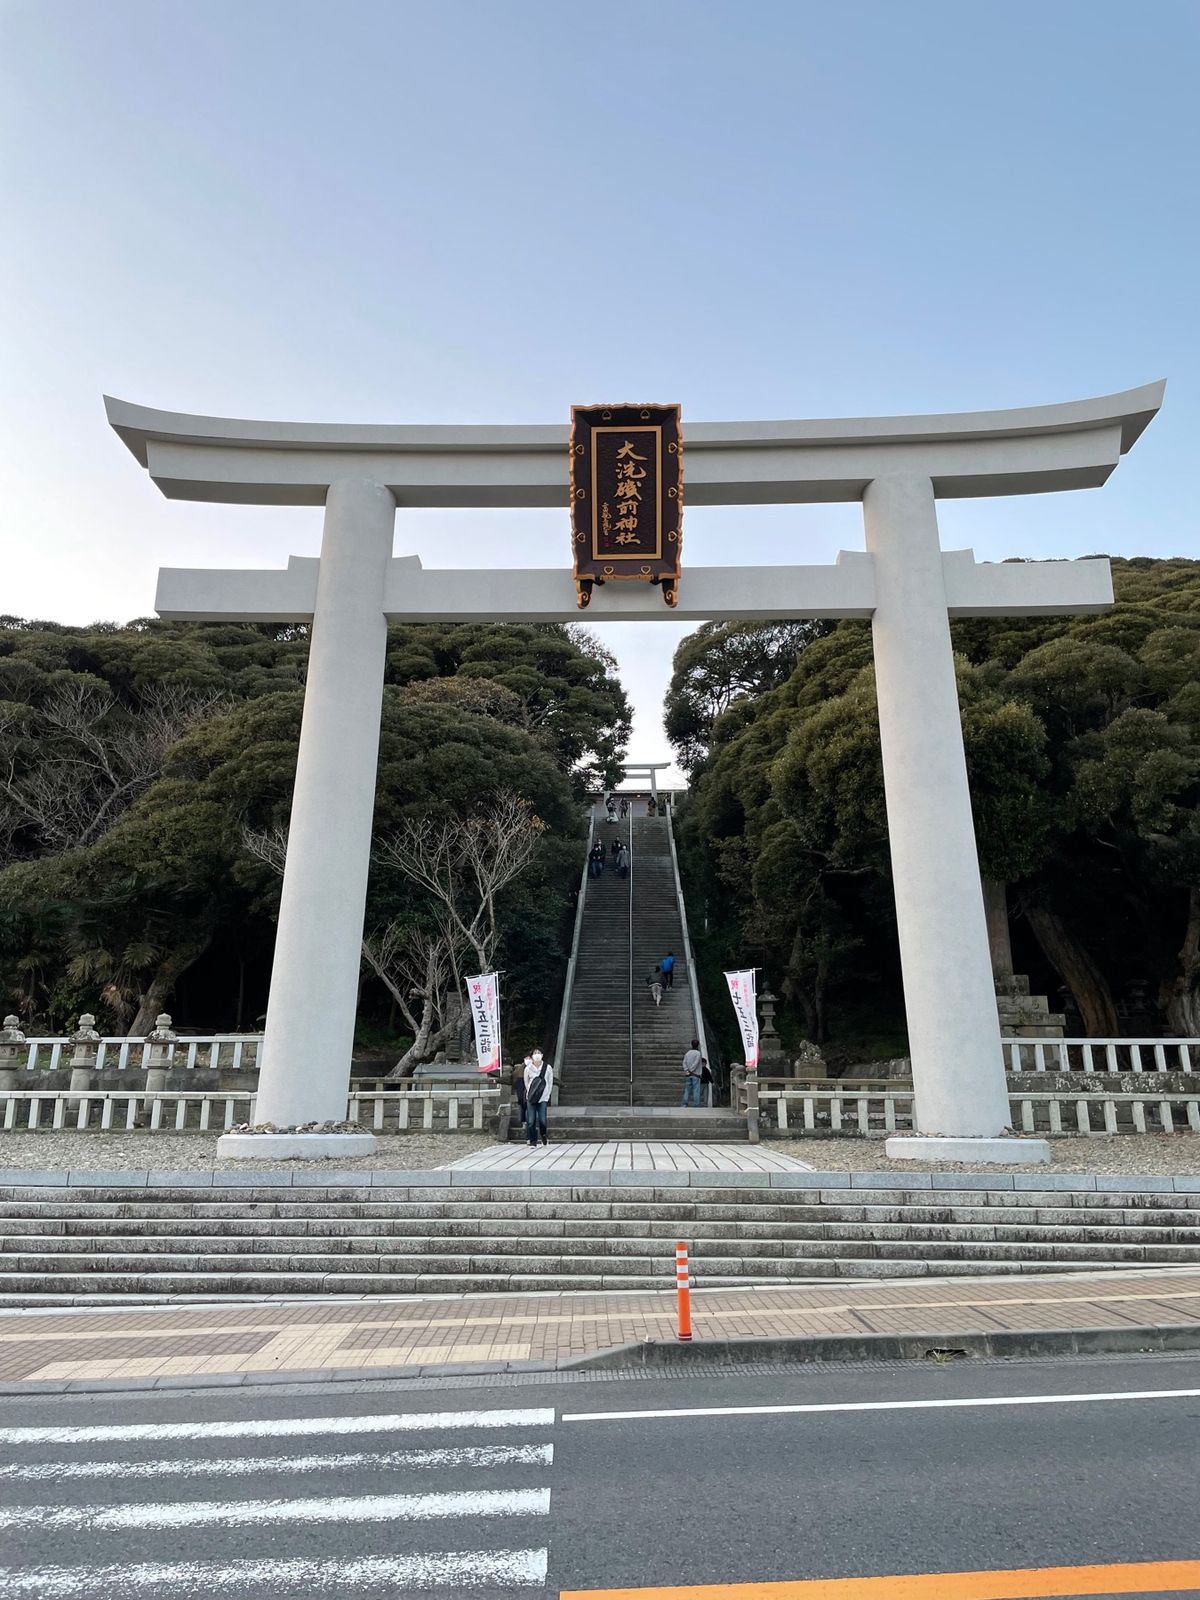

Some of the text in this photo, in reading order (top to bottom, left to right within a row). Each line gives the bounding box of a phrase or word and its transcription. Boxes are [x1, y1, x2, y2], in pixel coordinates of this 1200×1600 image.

[613, 440, 648, 545] 大洗磯前神社
